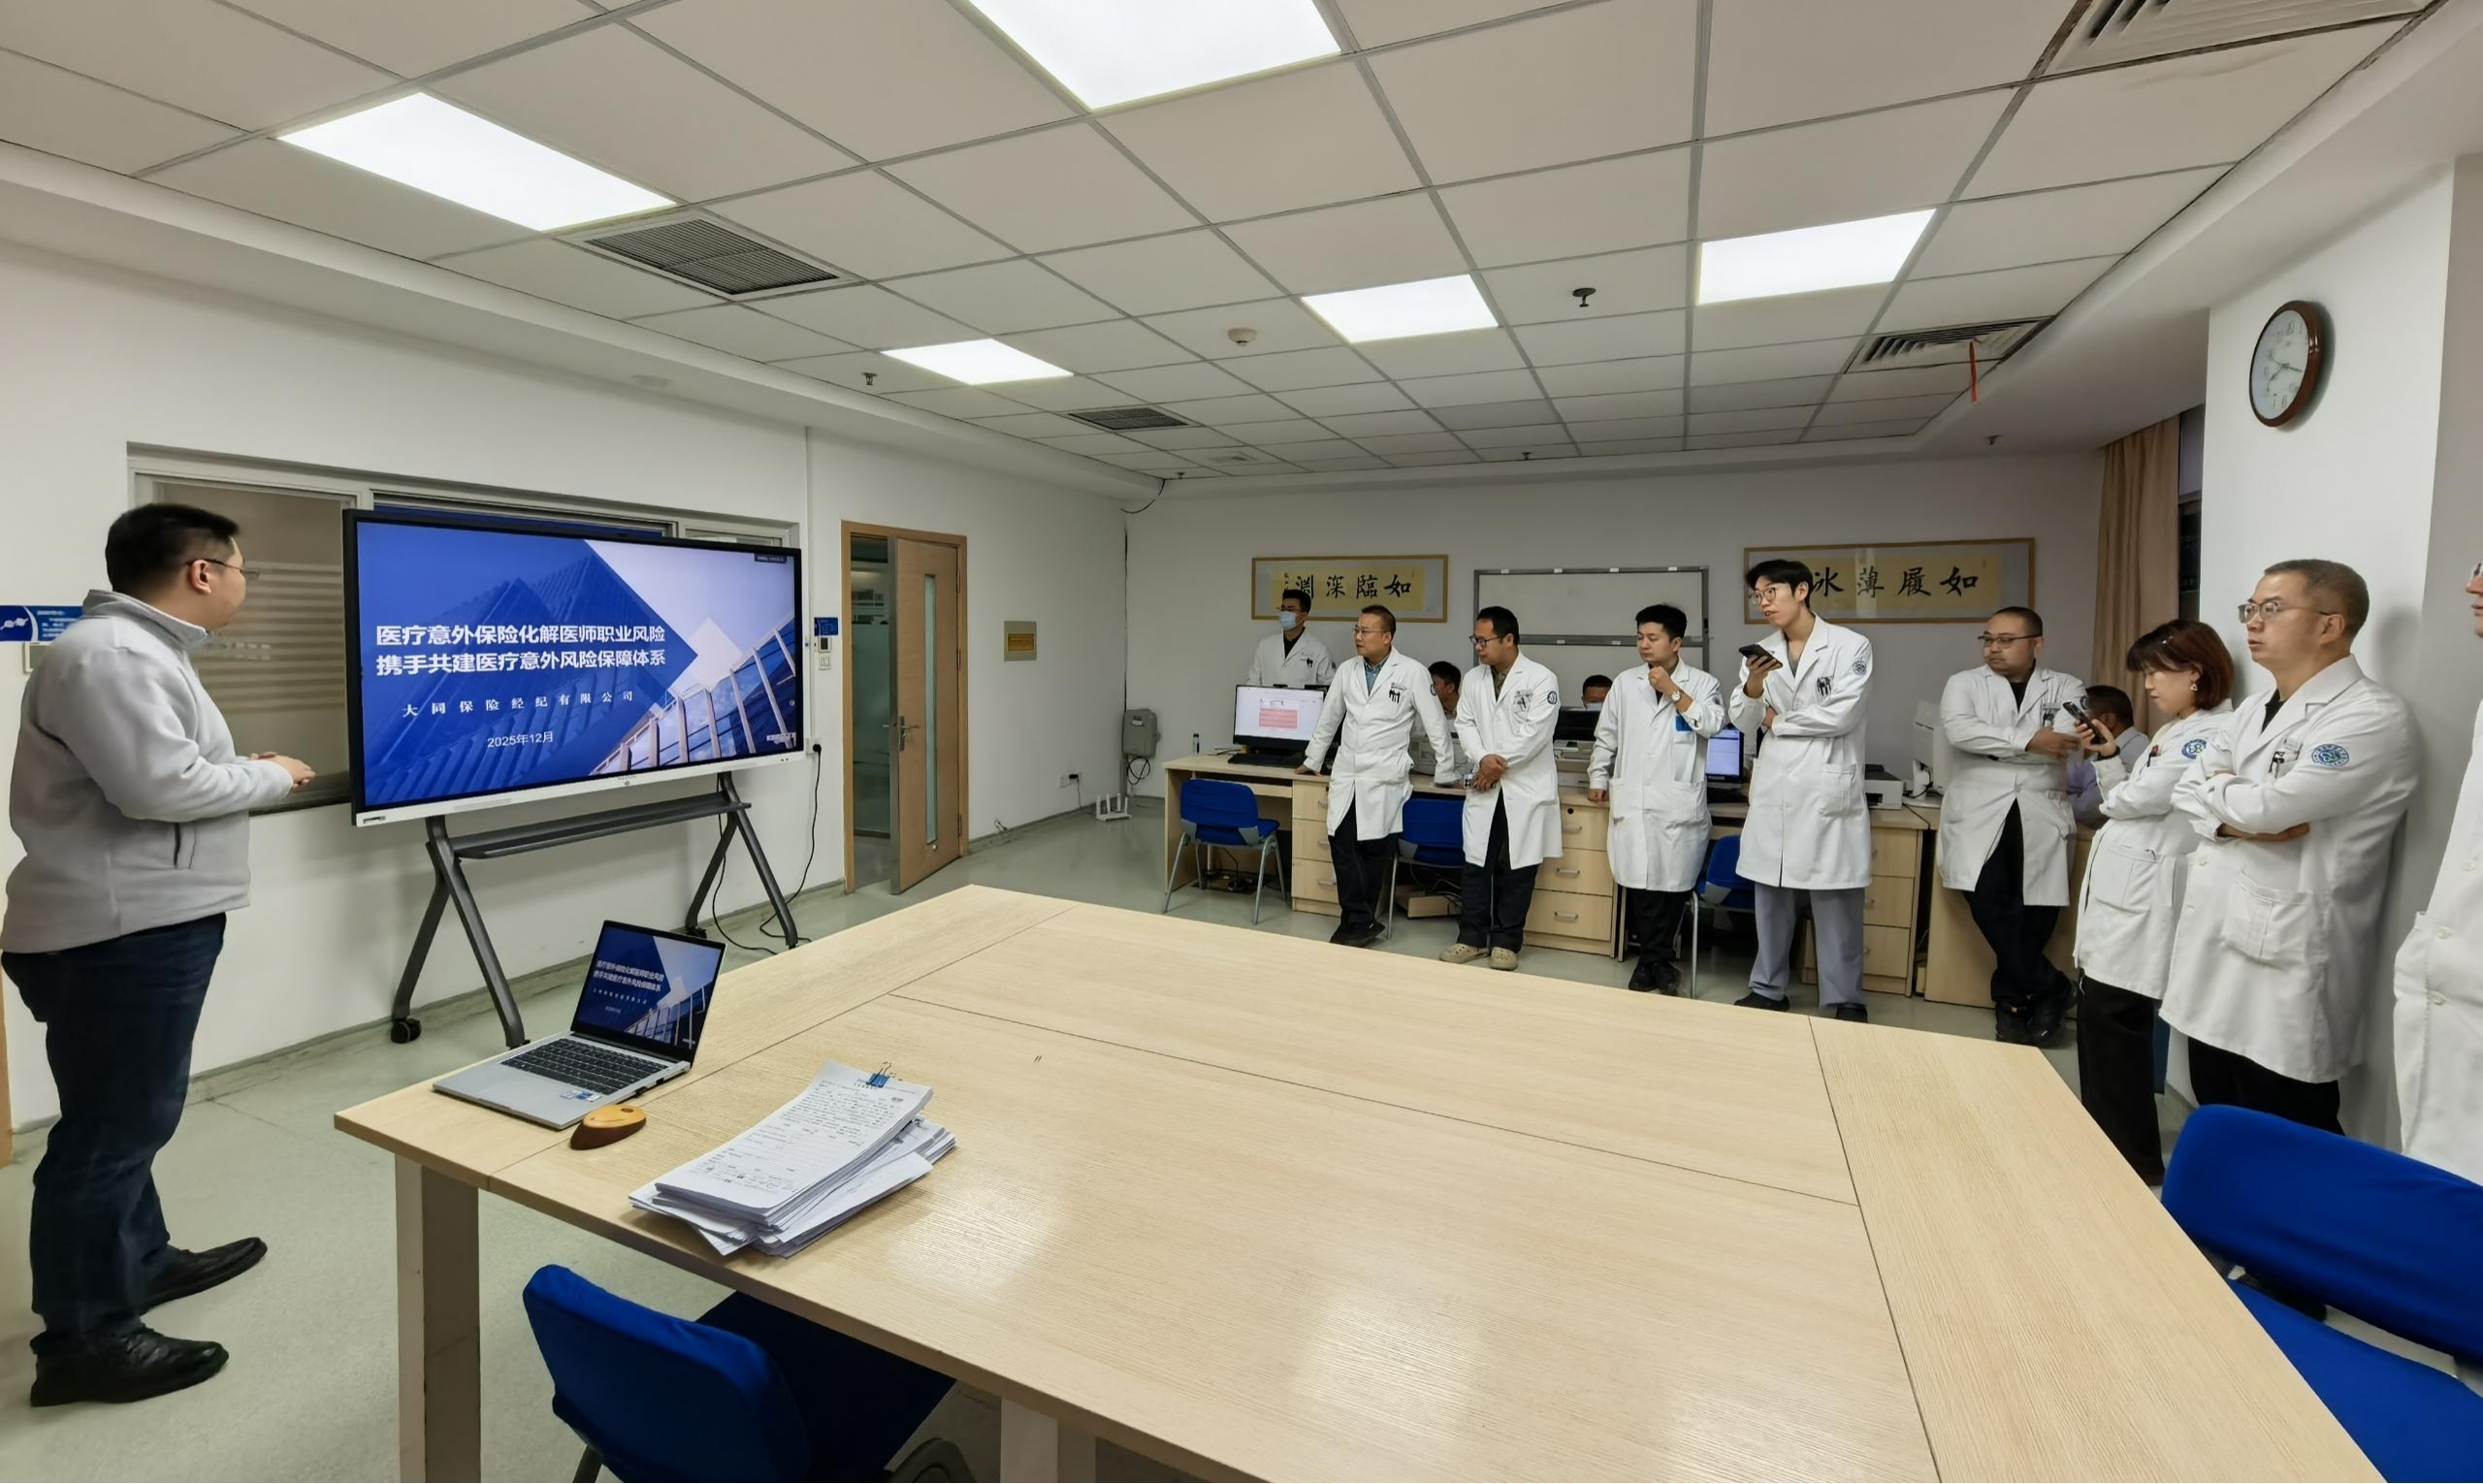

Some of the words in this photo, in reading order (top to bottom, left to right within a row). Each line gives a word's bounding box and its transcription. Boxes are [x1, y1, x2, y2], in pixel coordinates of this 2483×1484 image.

[376, 625, 665, 646] 医疗意外保险化解医师职业风险
[376, 649, 665, 676] 携手共建医疗意外风险保障体系
[403, 691, 633, 718] 大同保险经纪有限公司
[487, 730, 554, 748] 2025年12月
